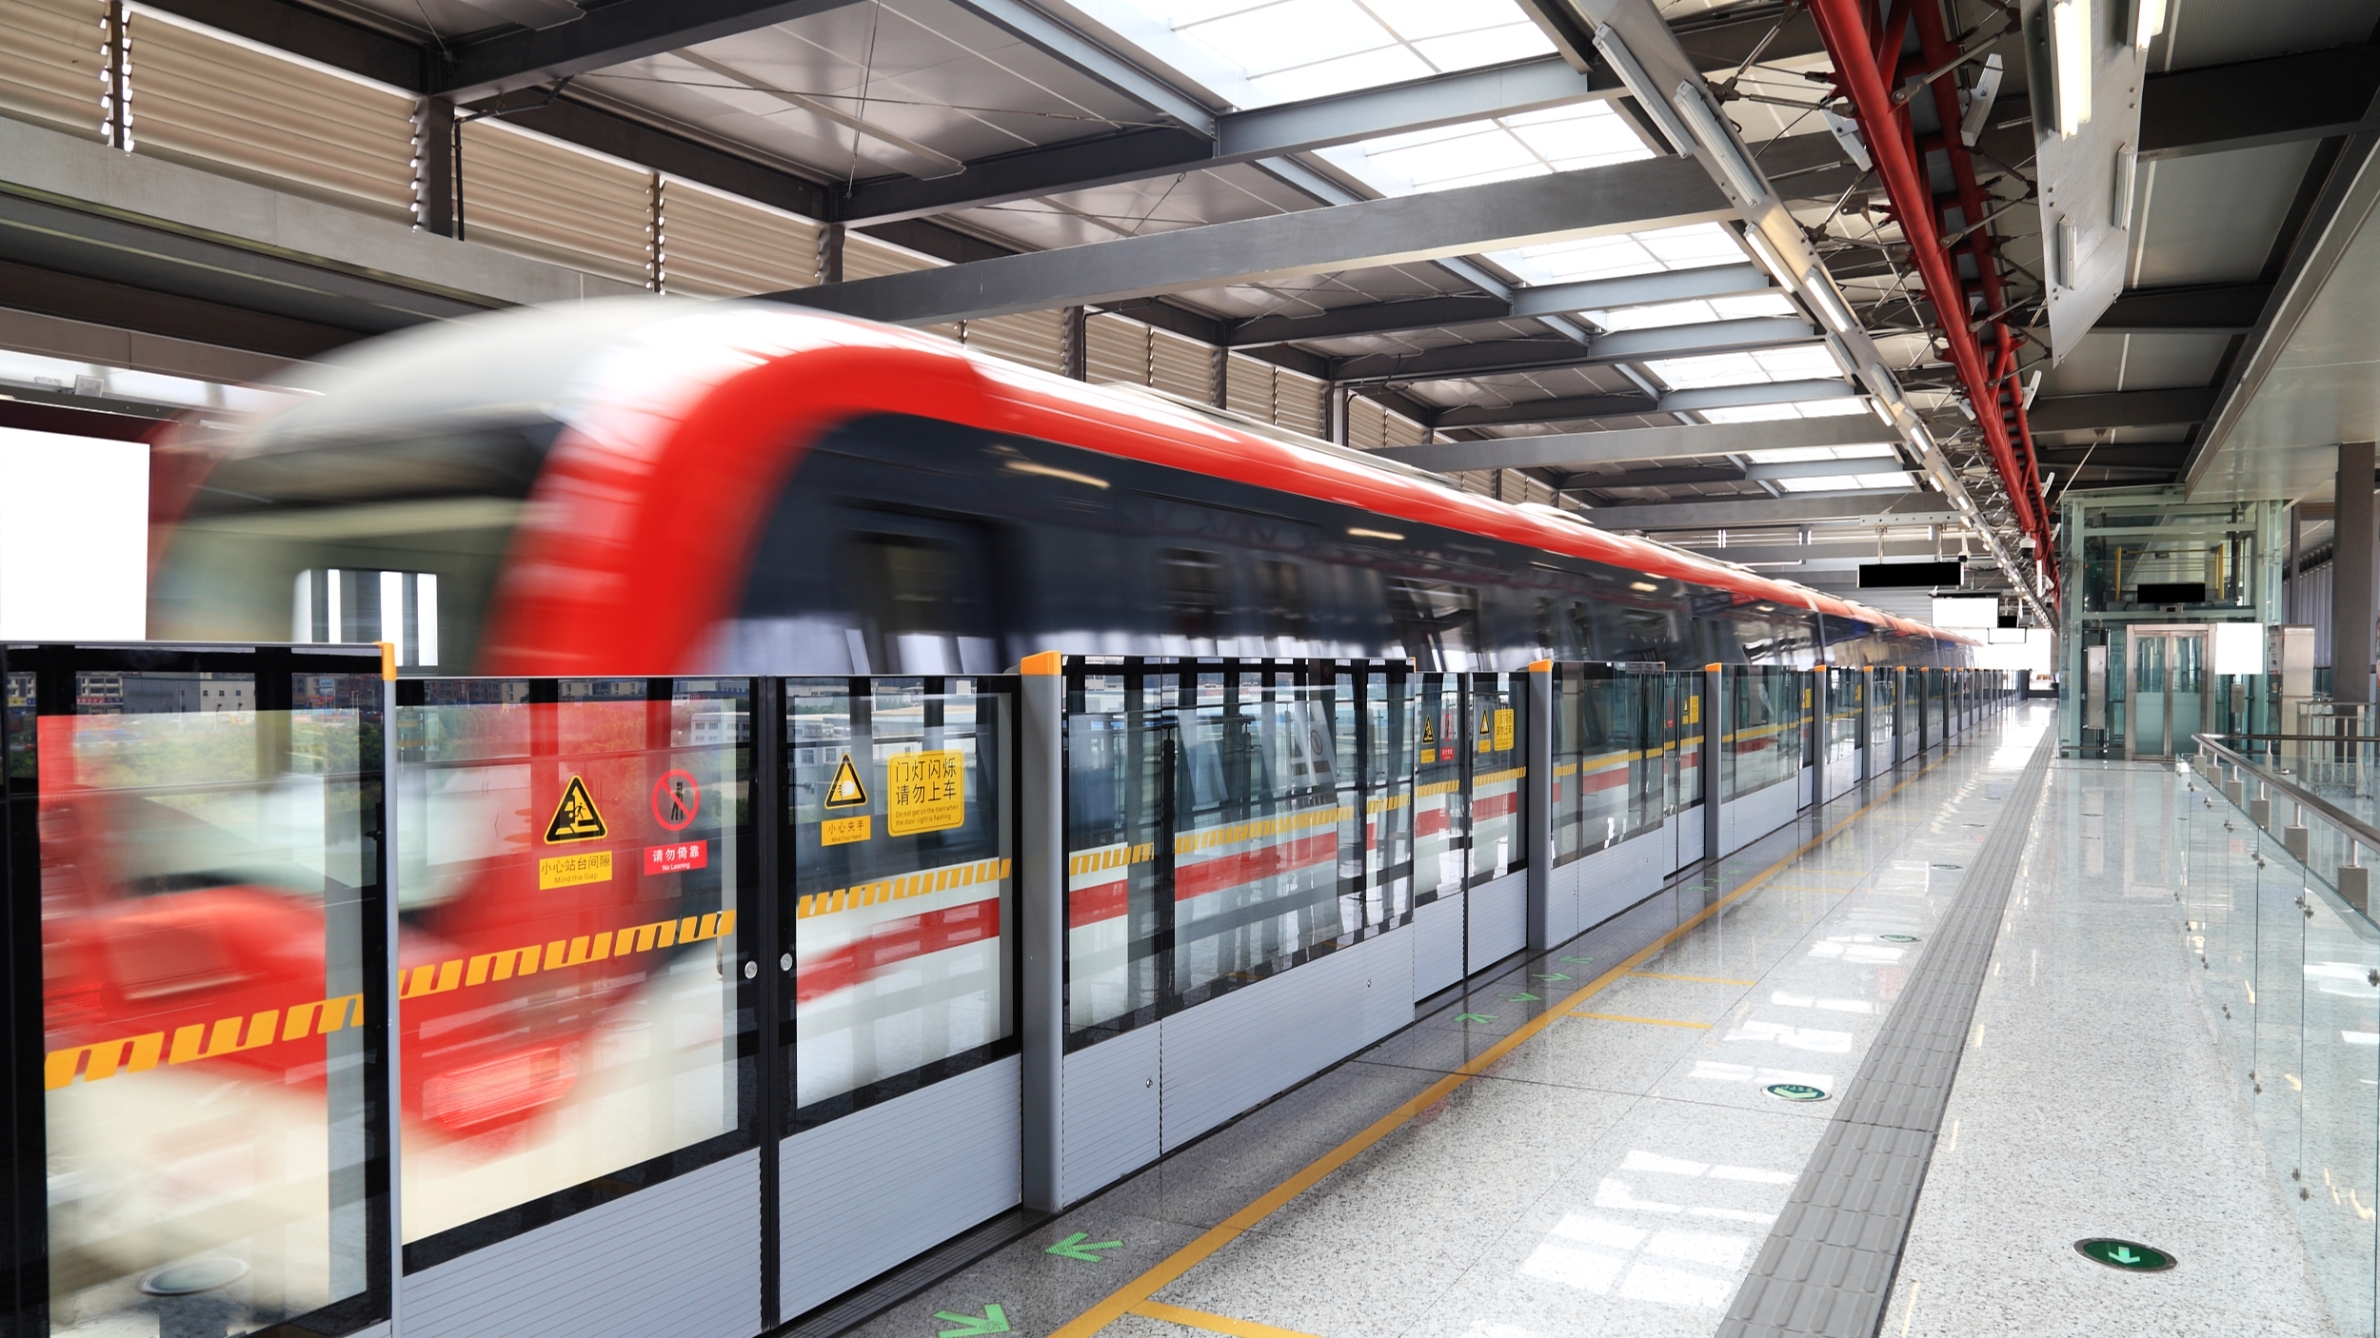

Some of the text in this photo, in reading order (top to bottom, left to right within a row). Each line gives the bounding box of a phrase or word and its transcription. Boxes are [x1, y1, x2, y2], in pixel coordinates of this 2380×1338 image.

[896, 757, 956, 783] 门灯闪烁
[896, 780, 956, 806] 请勿上车
[828, 819, 864, 835] 小心夹手
[653, 845, 700, 863] 请勿倚靠
[541, 853, 611, 876] 小心站台间隙
[670, 862, 690, 871] Leaning
[554, 872, 598, 884] Mind the Gap
